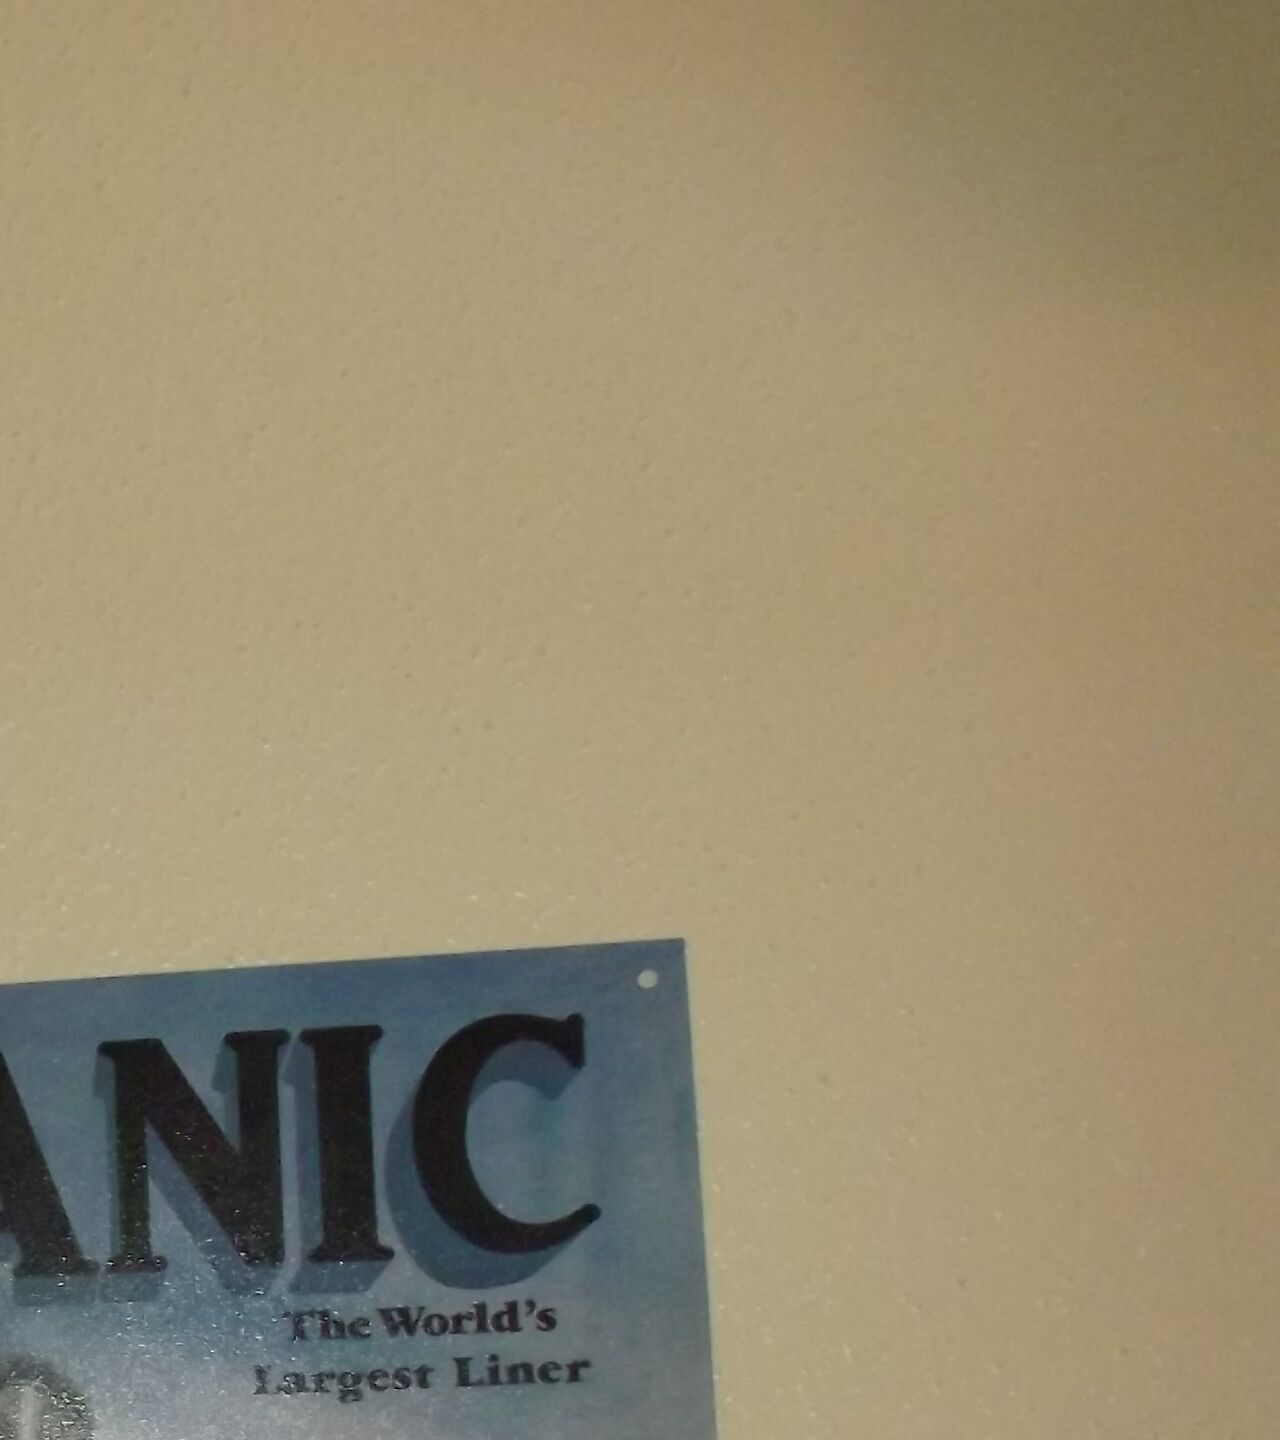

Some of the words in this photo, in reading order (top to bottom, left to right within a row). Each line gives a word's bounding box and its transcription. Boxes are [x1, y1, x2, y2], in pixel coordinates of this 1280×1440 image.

[284, 1307, 371, 1341] The
[376, 1299, 557, 1337] World's
[253, 1363, 434, 1404] Largest
[454, 1353, 592, 1388] Liner
